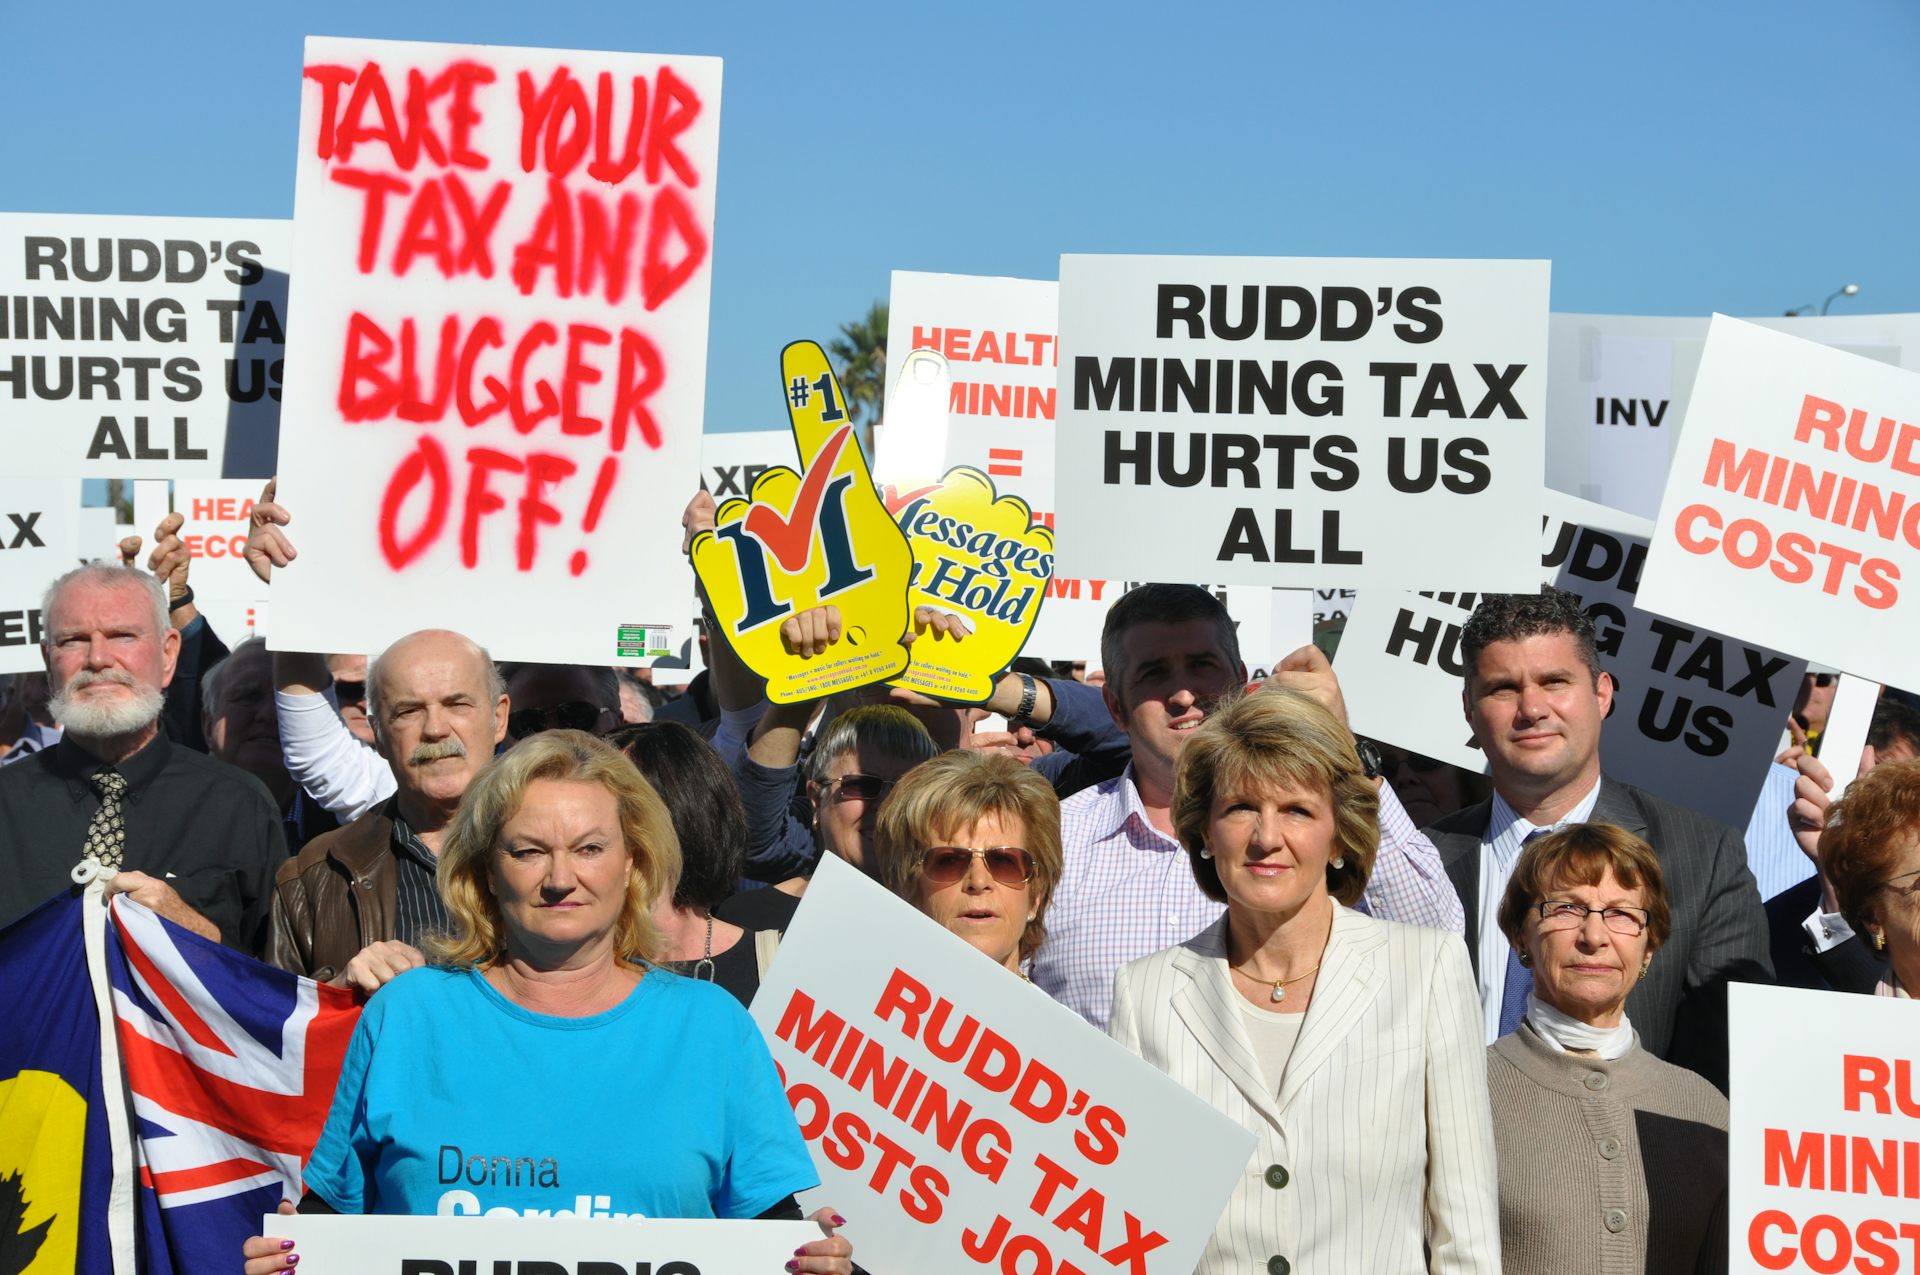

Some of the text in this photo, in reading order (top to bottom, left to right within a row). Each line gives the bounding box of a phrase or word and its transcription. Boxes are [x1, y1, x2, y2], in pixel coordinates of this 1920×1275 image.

[302, 58, 703, 188] TAKE YOUR
[25, 236, 264, 286] RUDD'S
[331, 166, 708, 313] TAX AND
[0, 295, 187, 343] INING
[1156, 283, 1443, 344] RUDD'S
[912, 326, 1058, 367] HEALT
[336, 310, 666, 452] BUGGER
[791, 373, 843, 422] #1
[1073, 356, 1528, 420] MINING TAX
[1596, 397, 1669, 427] INV
[86, 416, 208, 460] ALL
[1103, 430, 1491, 495] HURTS US
[378, 433, 619, 577] OFF!
[1216, 507, 1363, 565] ALL
[1675, 504, 1902, 610] COSTS
[921, 556, 1035, 624] Hold
[1650, 619, 1790, 708] TAX
[1638, 687, 1734, 757] US
[874, 967, 1127, 1166] RUDD'S
[775, 988, 1169, 1275] MINING TAX
[437, 1145, 560, 1188] Donna
[961, 1213, 1087, 1275] JO
